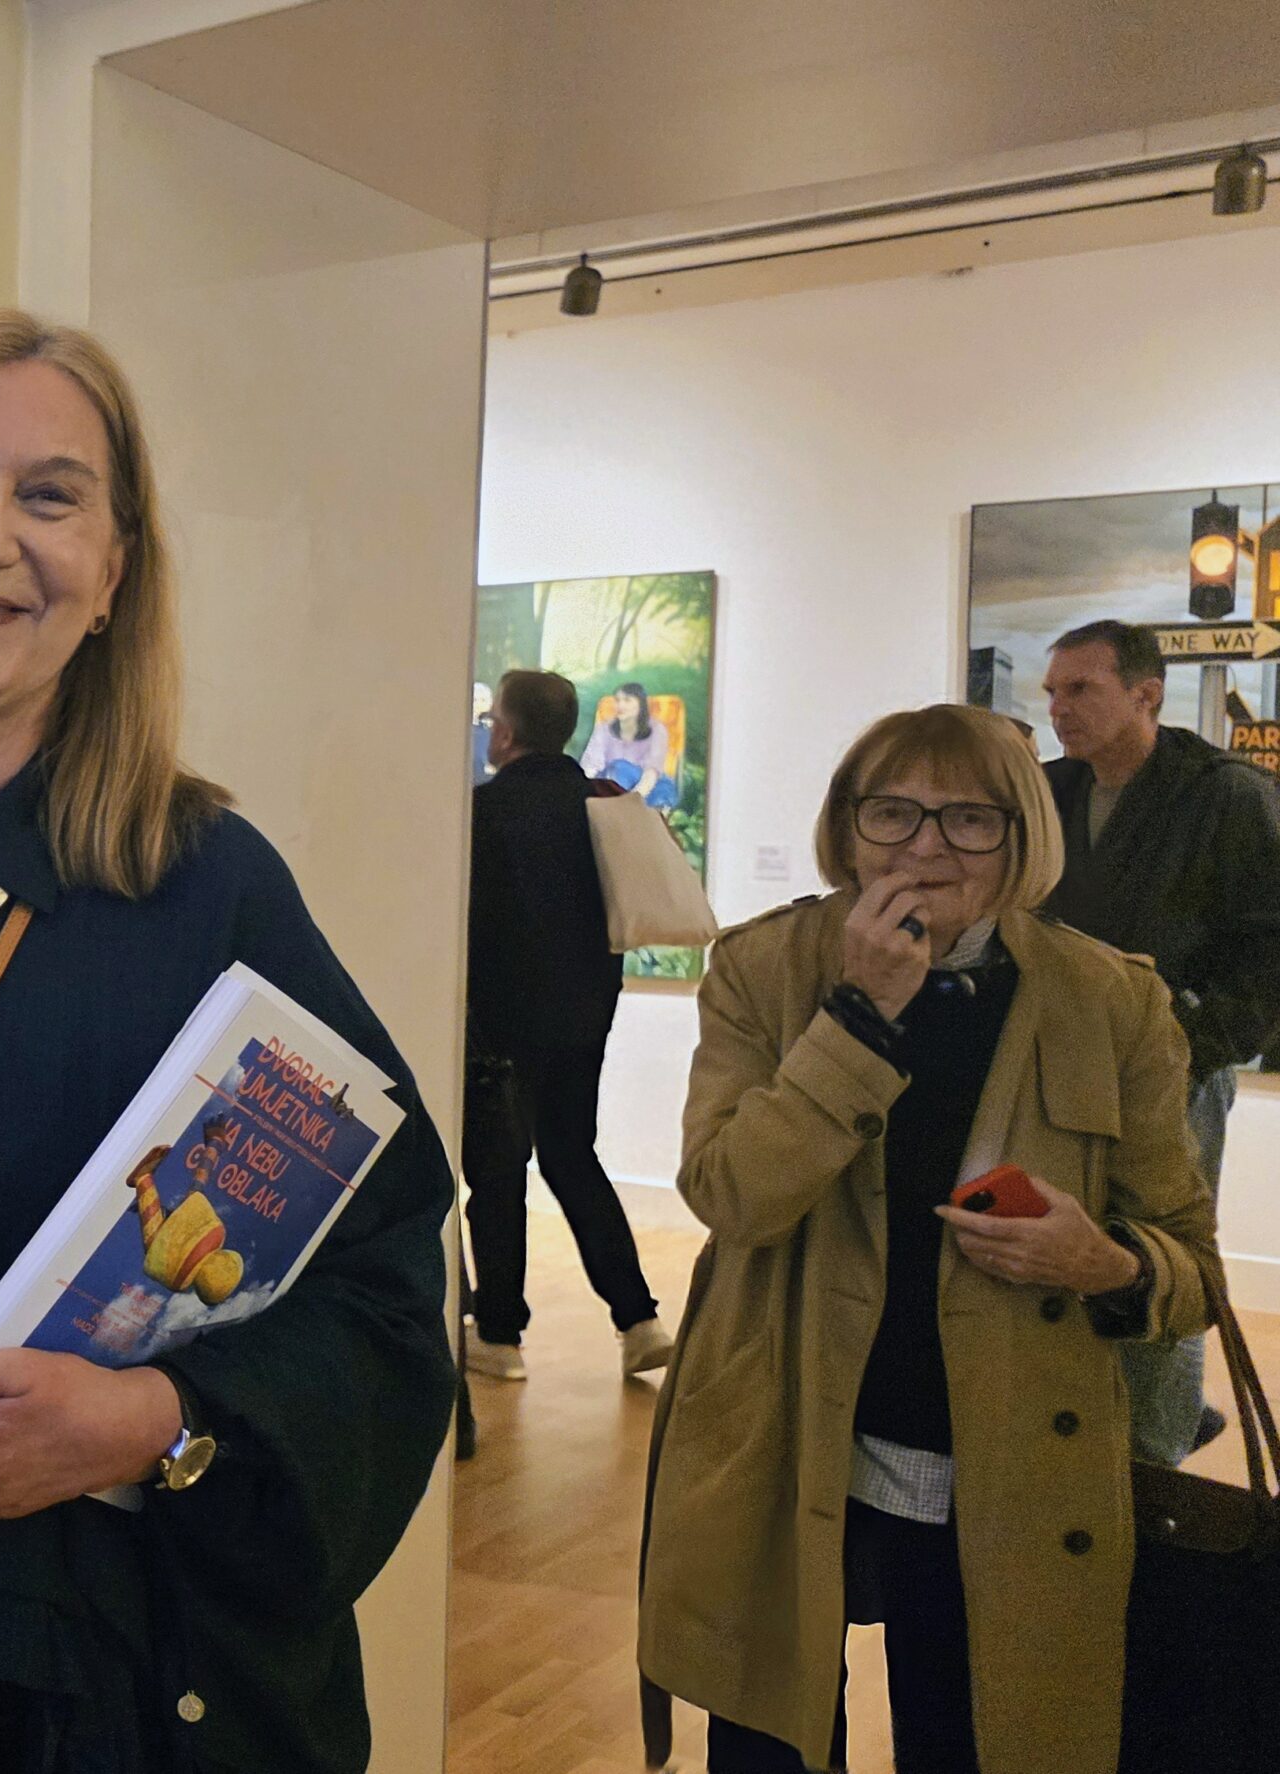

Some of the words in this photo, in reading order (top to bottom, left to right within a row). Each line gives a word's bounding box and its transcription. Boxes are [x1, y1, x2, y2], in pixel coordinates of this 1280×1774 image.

[1212, 631, 1261, 650] WAY
[257, 1036, 334, 1106] DVORAC
[238, 1066, 336, 1153] UMJETNIKA
[237, 1133, 292, 1181] NEBU
[217, 1163, 288, 1224] OBLAKA
